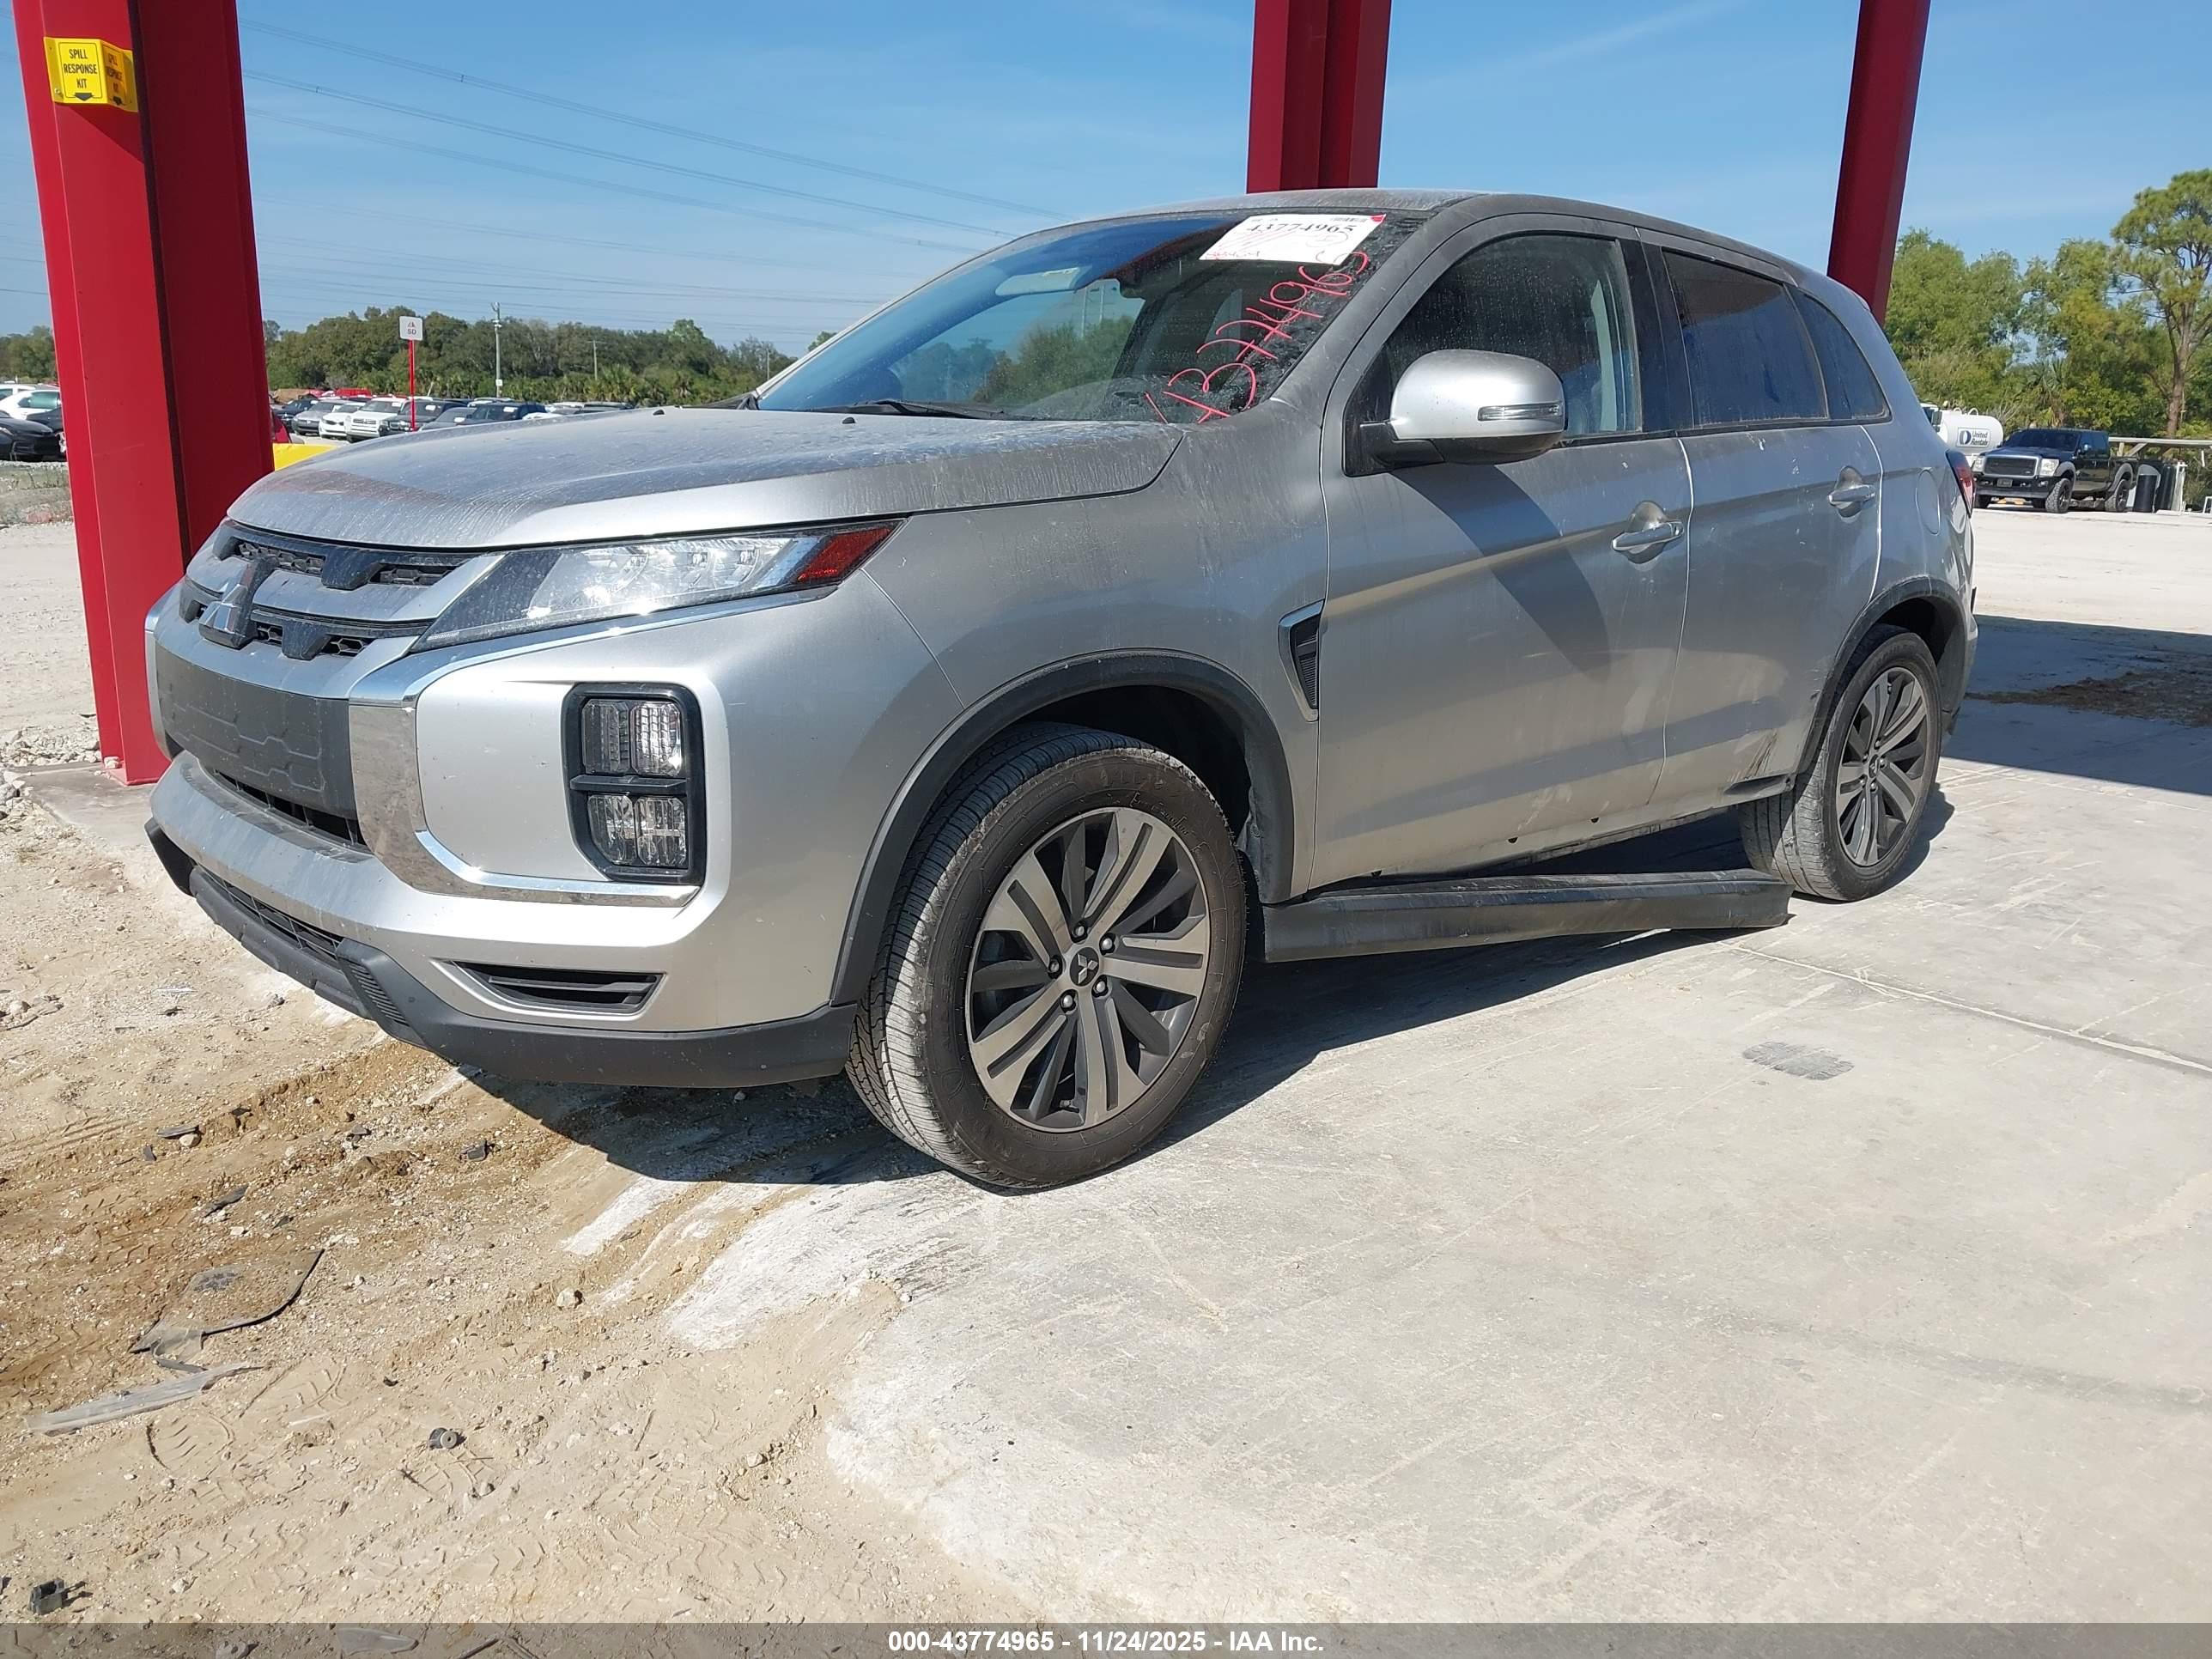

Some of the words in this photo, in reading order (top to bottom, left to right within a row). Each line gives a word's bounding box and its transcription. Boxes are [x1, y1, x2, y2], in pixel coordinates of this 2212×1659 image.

[69, 49, 88, 59] SPILL
[63, 64, 98, 75] RESPONSE
[76, 78, 88, 88] KIT
